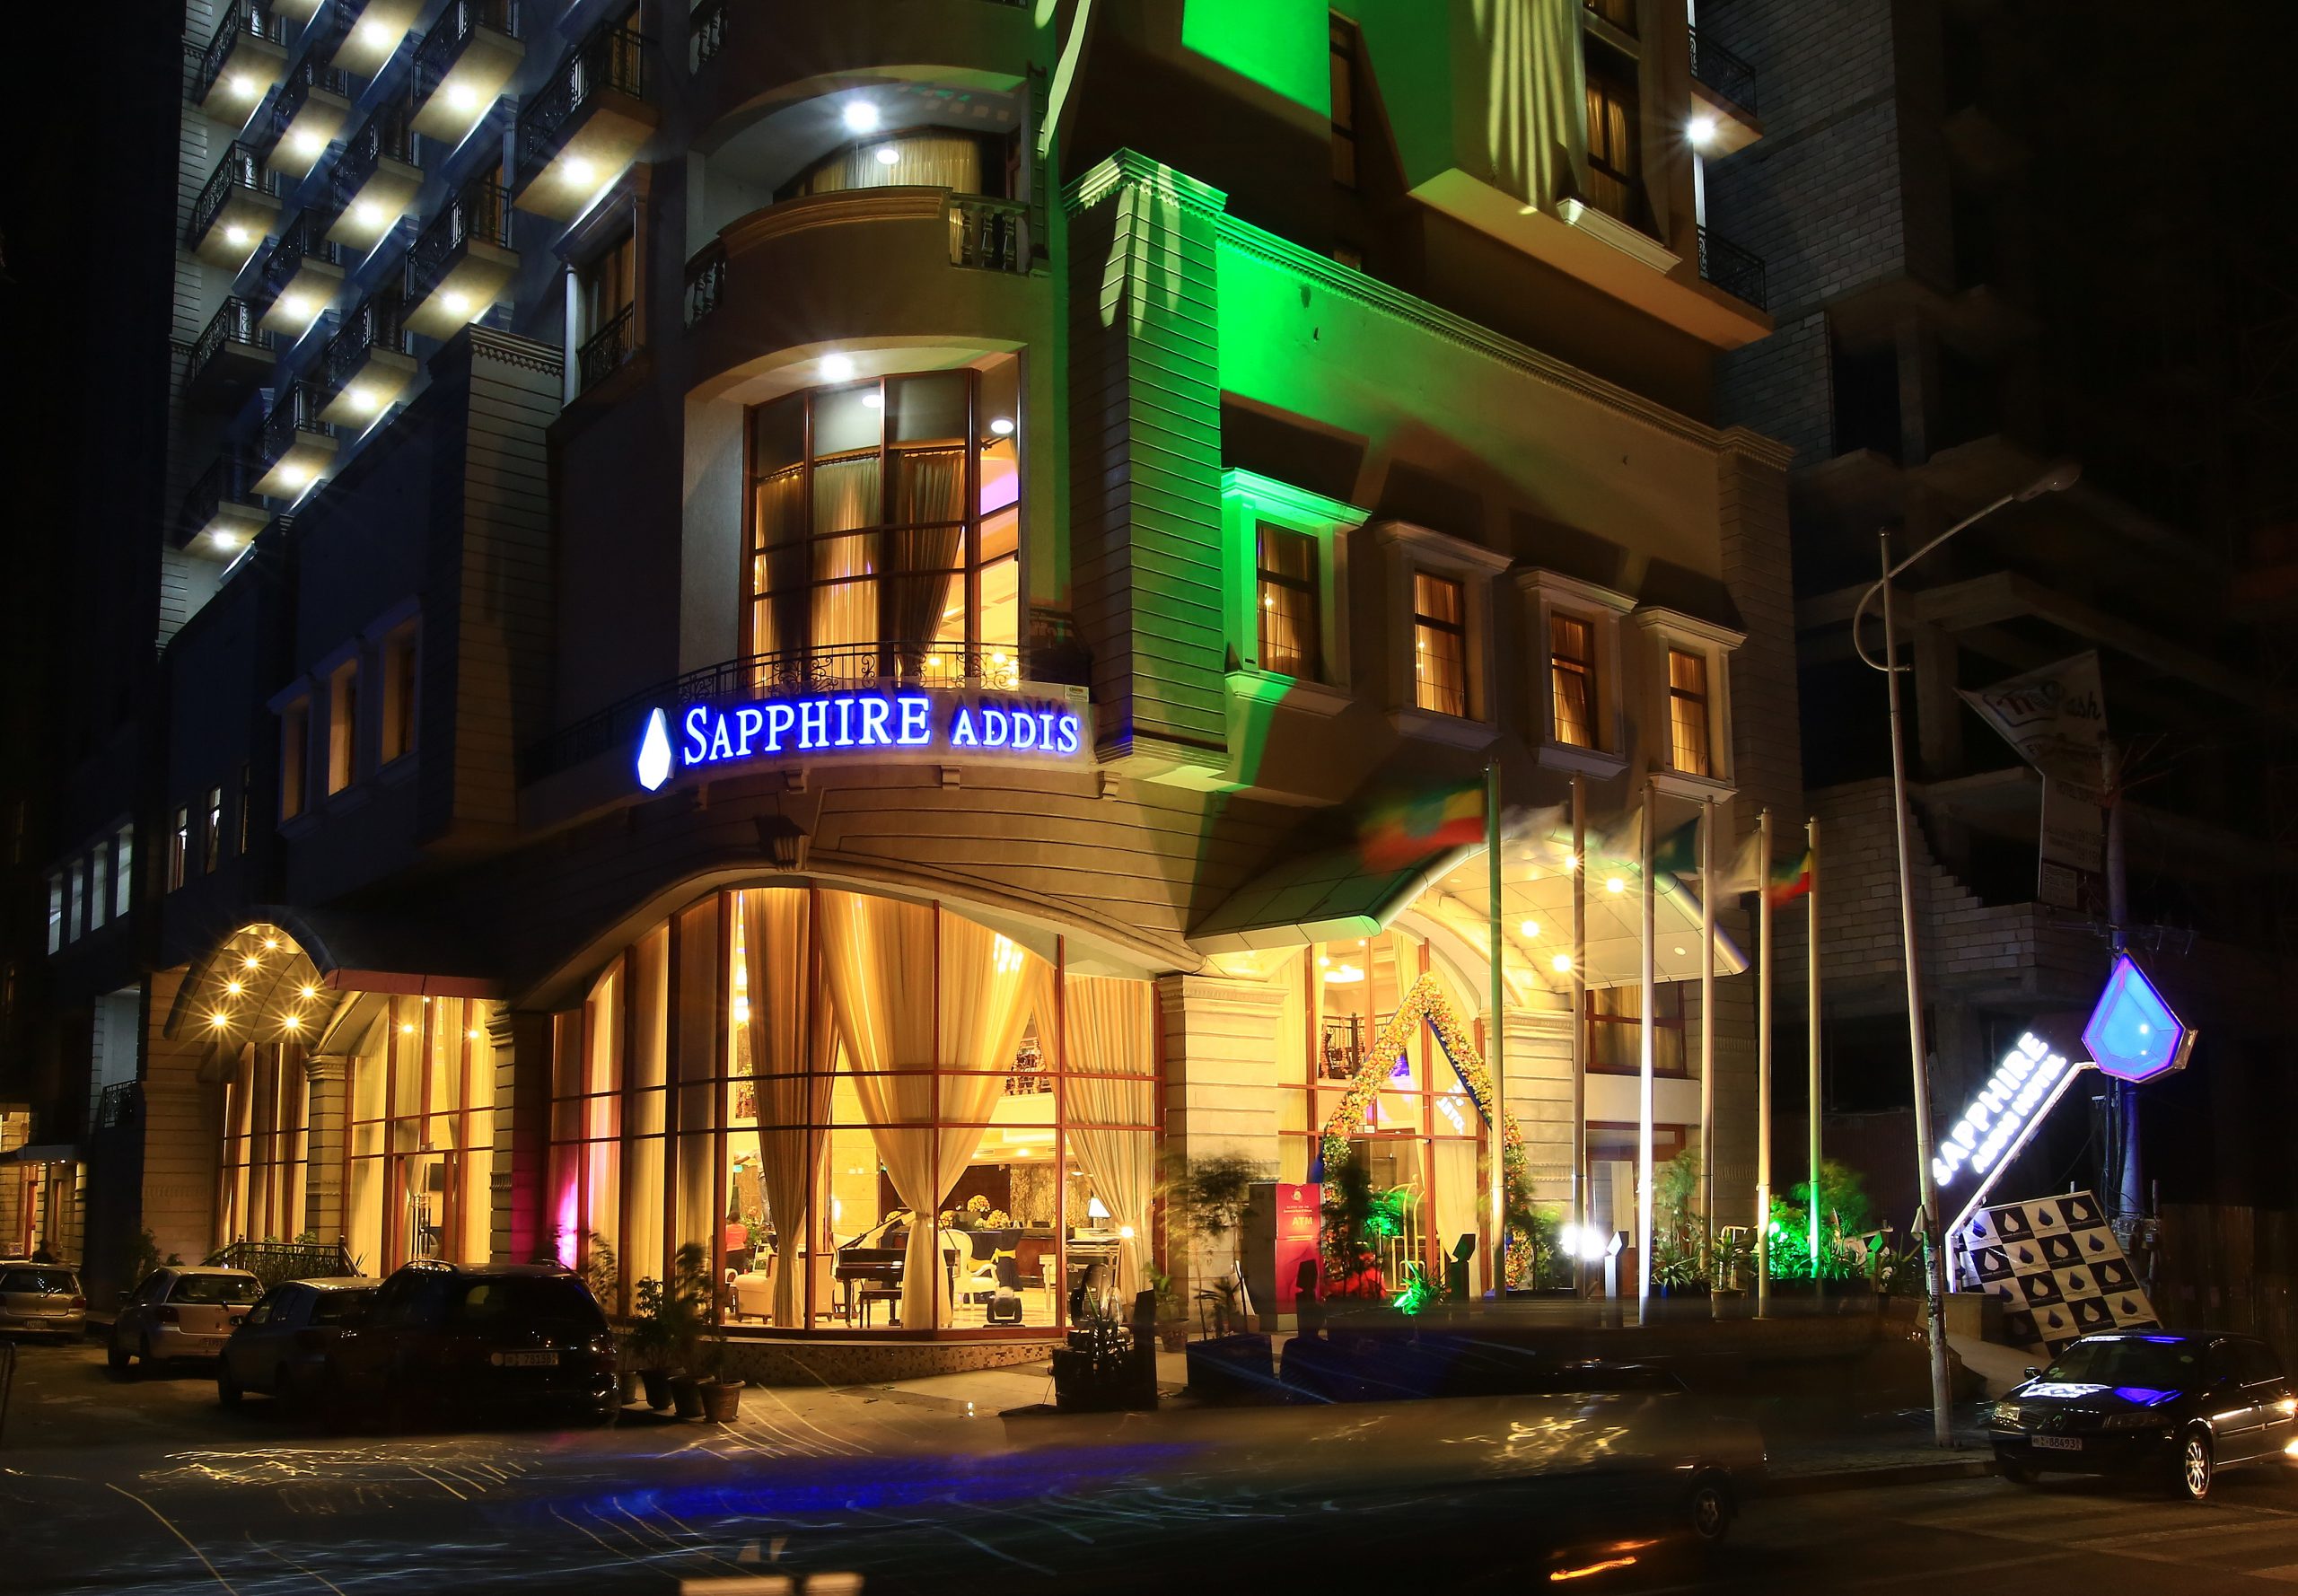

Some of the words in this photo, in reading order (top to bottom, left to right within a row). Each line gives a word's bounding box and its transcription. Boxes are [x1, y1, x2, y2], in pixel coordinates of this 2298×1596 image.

[684, 697, 931, 766] SAPPHIRE
[952, 709, 1079, 753] ADDIS
[1932, 1031, 2049, 1187] SAPPHIRE
[1292, 1216, 1313, 1226] ATM
